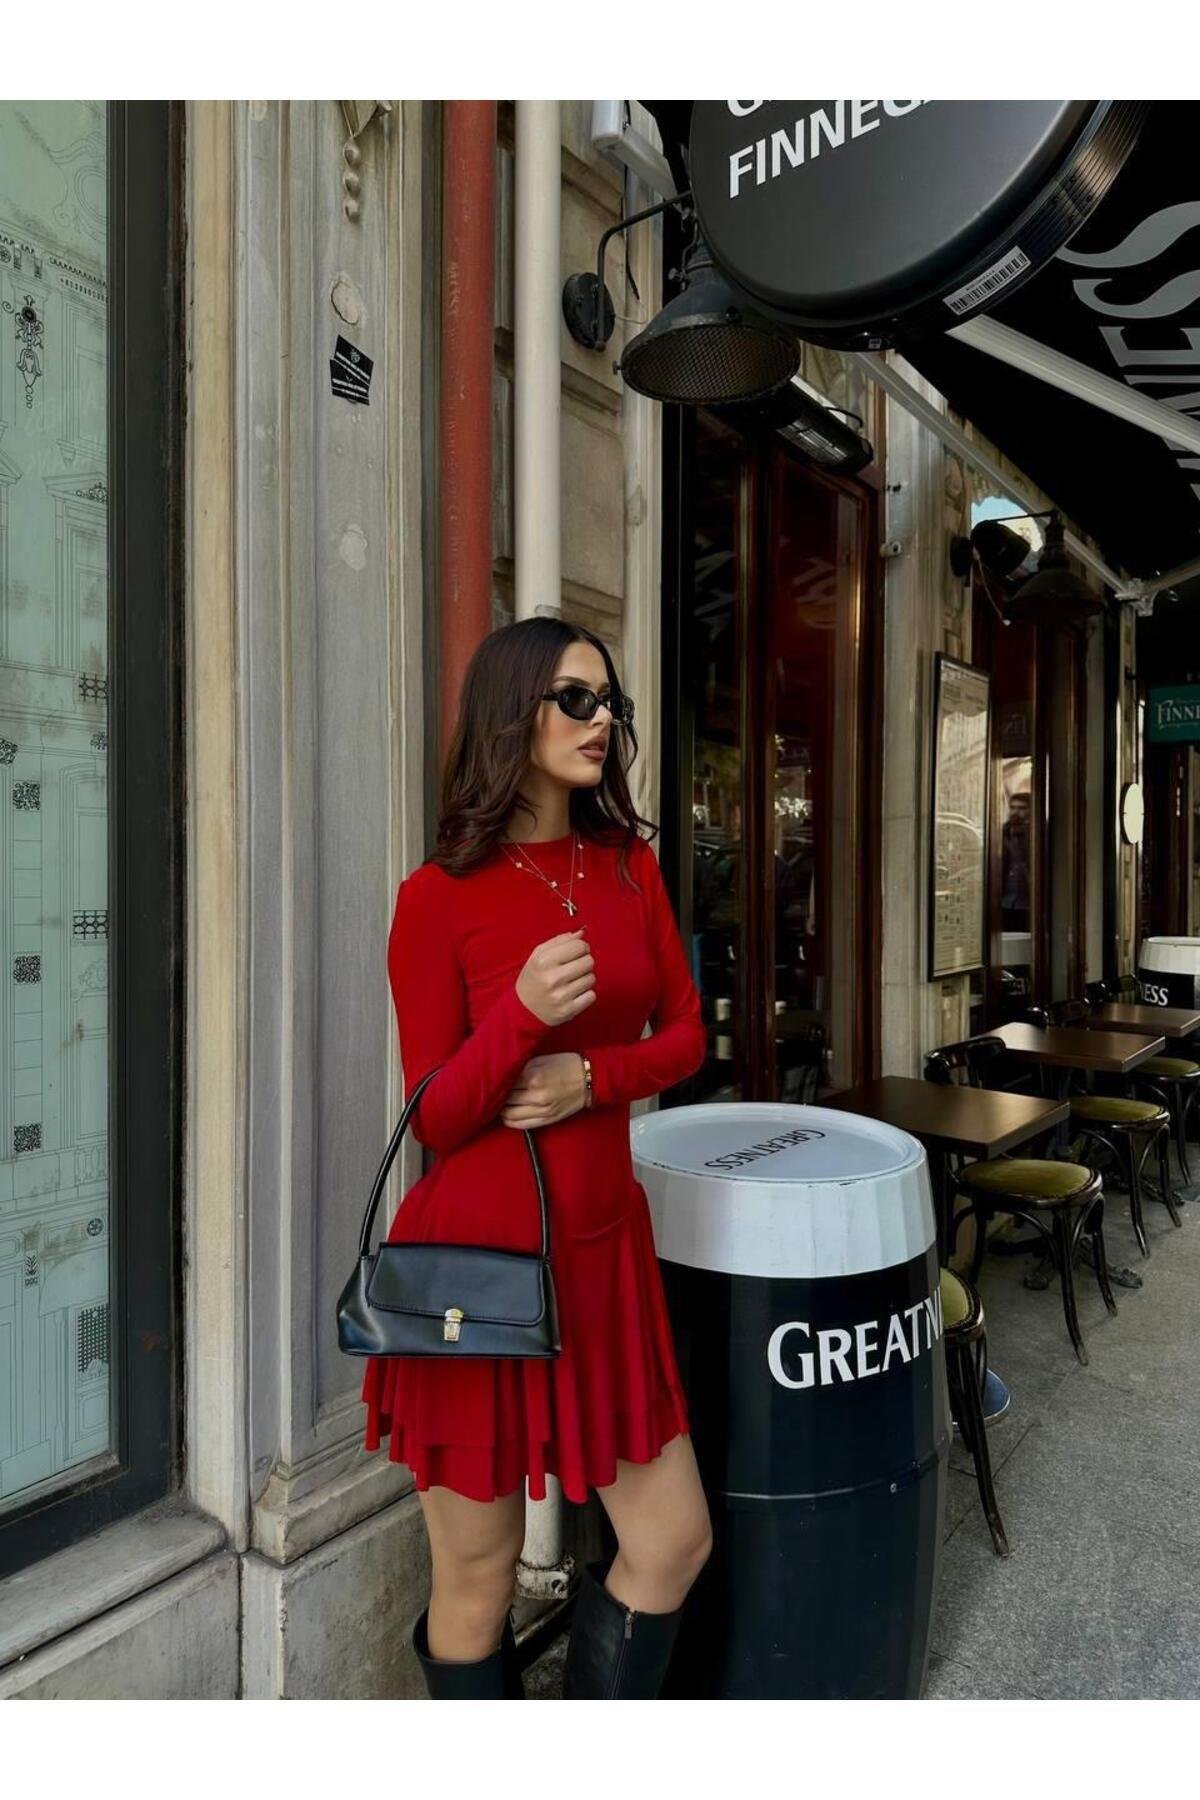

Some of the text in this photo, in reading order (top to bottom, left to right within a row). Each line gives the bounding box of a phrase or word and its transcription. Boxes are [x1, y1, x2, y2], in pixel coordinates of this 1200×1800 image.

[729, 100, 934, 199] FINNE
[1140, 983, 1169, 1006] ESS
[704, 1129, 826, 1170] GREATNESS
